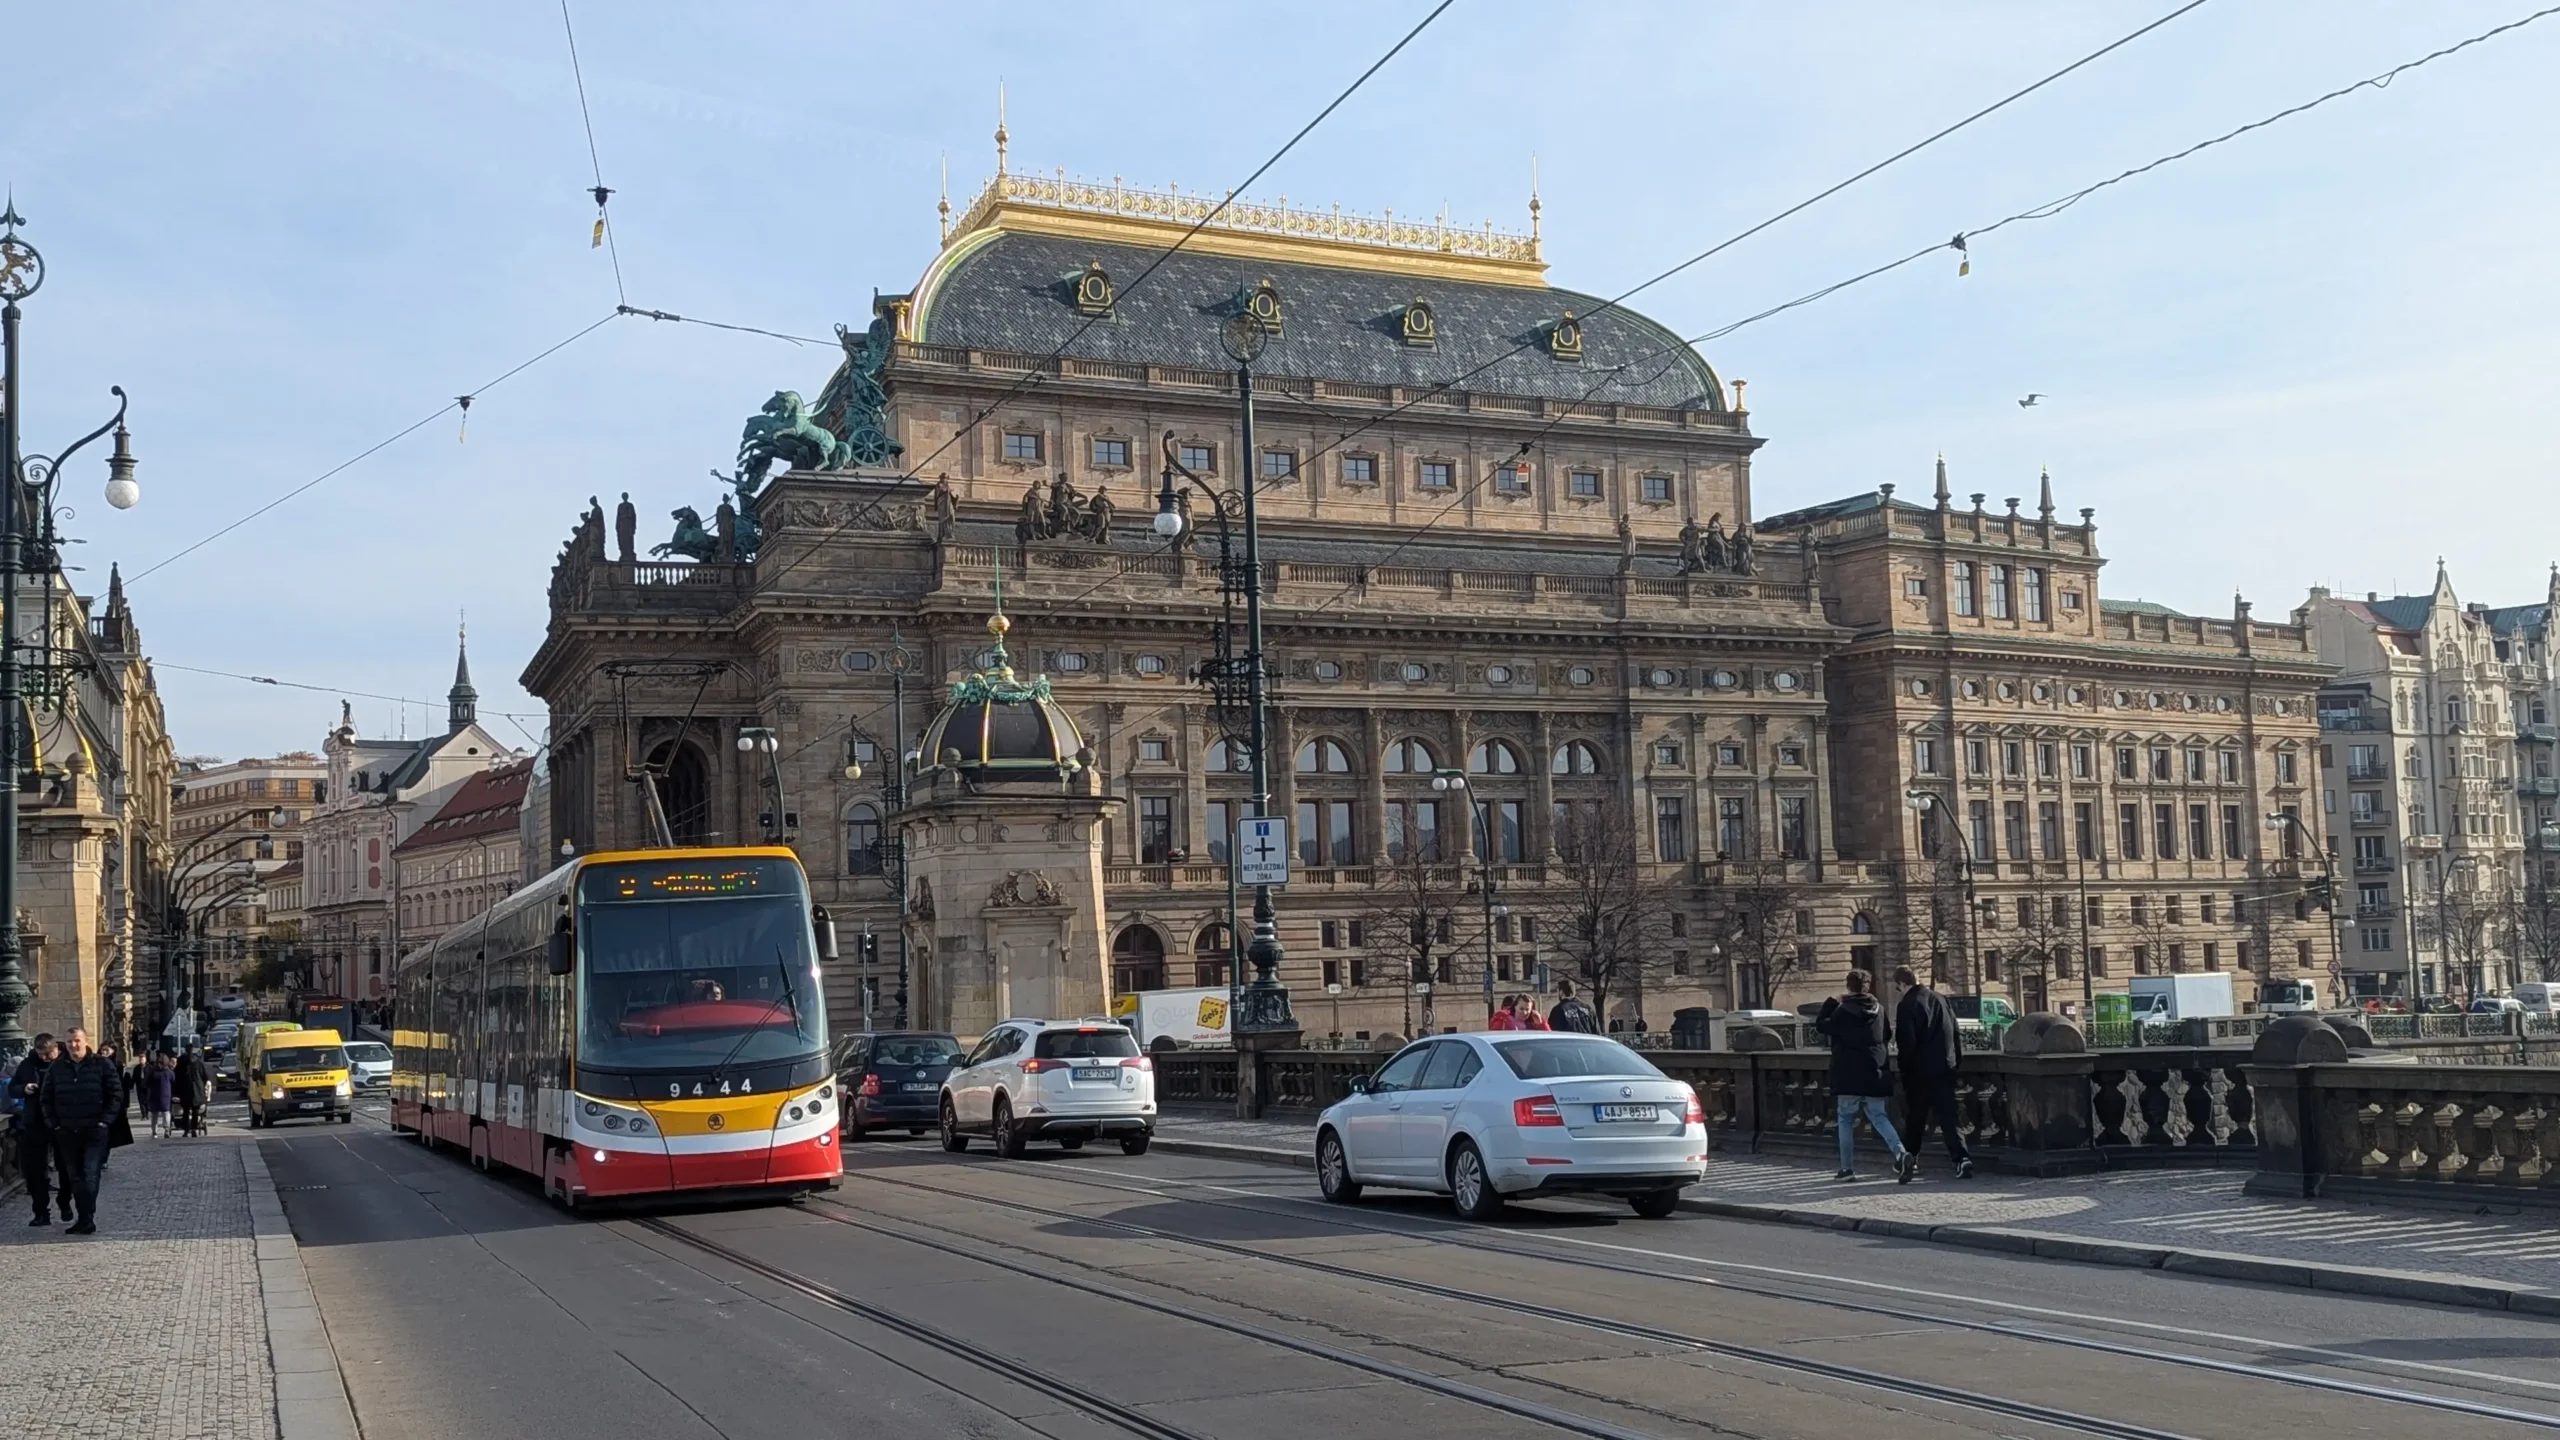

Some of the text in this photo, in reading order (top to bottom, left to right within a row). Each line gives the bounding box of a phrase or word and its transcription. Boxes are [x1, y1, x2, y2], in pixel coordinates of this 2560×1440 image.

[1243, 862, 1285, 871] NEPRŮJEZDNÁ
[1256, 872, 1272, 880] ZÓNA
[1201, 1008, 1219, 1023] Geis
[286, 1075, 336, 1083] MESSENGER
[670, 1078, 752, 1098] 9444
[1604, 1105, 1654, 1118] 4AJ 8531
